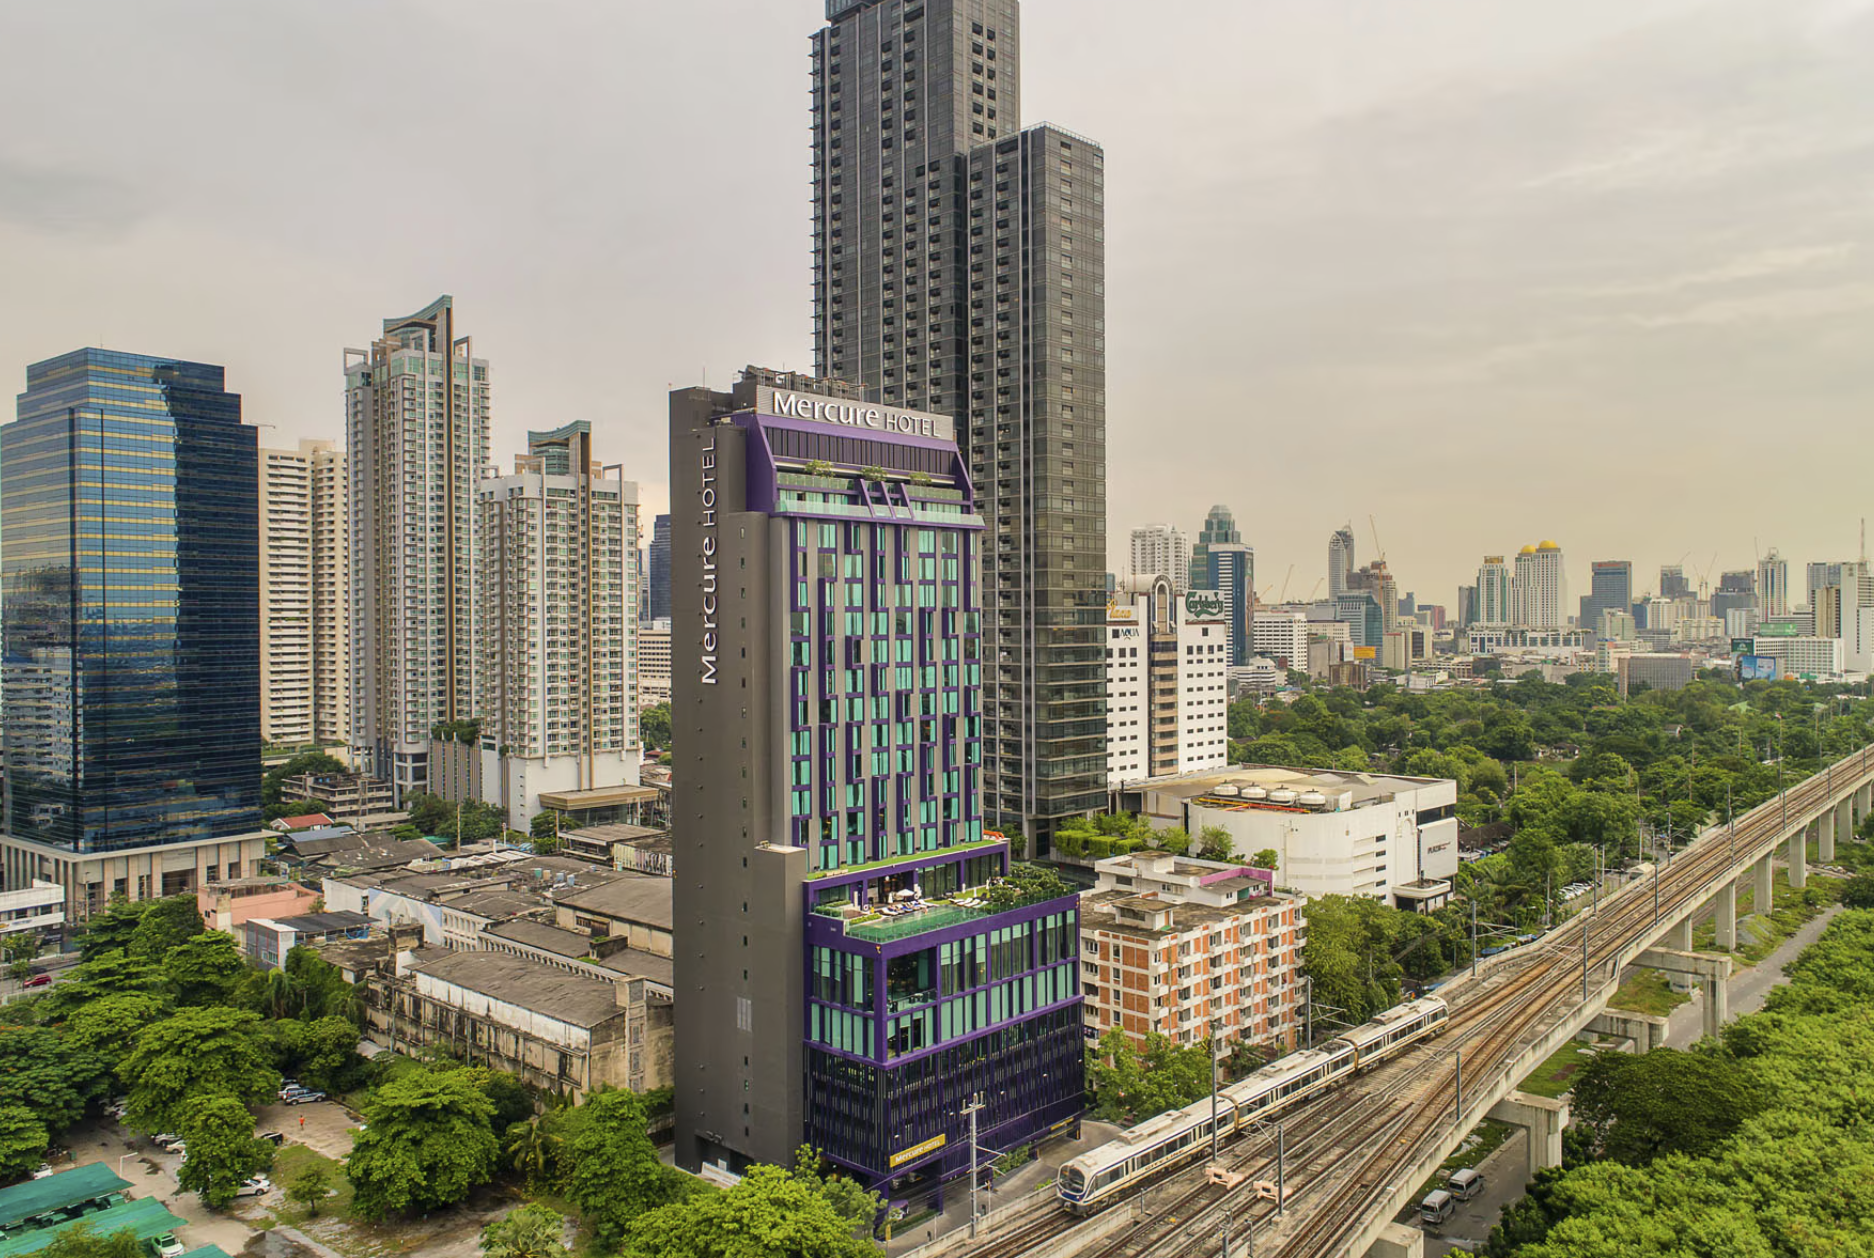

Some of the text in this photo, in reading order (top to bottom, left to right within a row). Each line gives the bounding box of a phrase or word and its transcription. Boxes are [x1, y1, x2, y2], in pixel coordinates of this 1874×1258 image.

[773, 391, 942, 437] Mercure HOTEL
[702, 437, 718, 684] Mercure HOTEL
[1185, 591, 1224, 618] Carlsberg
[895, 1147, 924, 1163] Mercure
